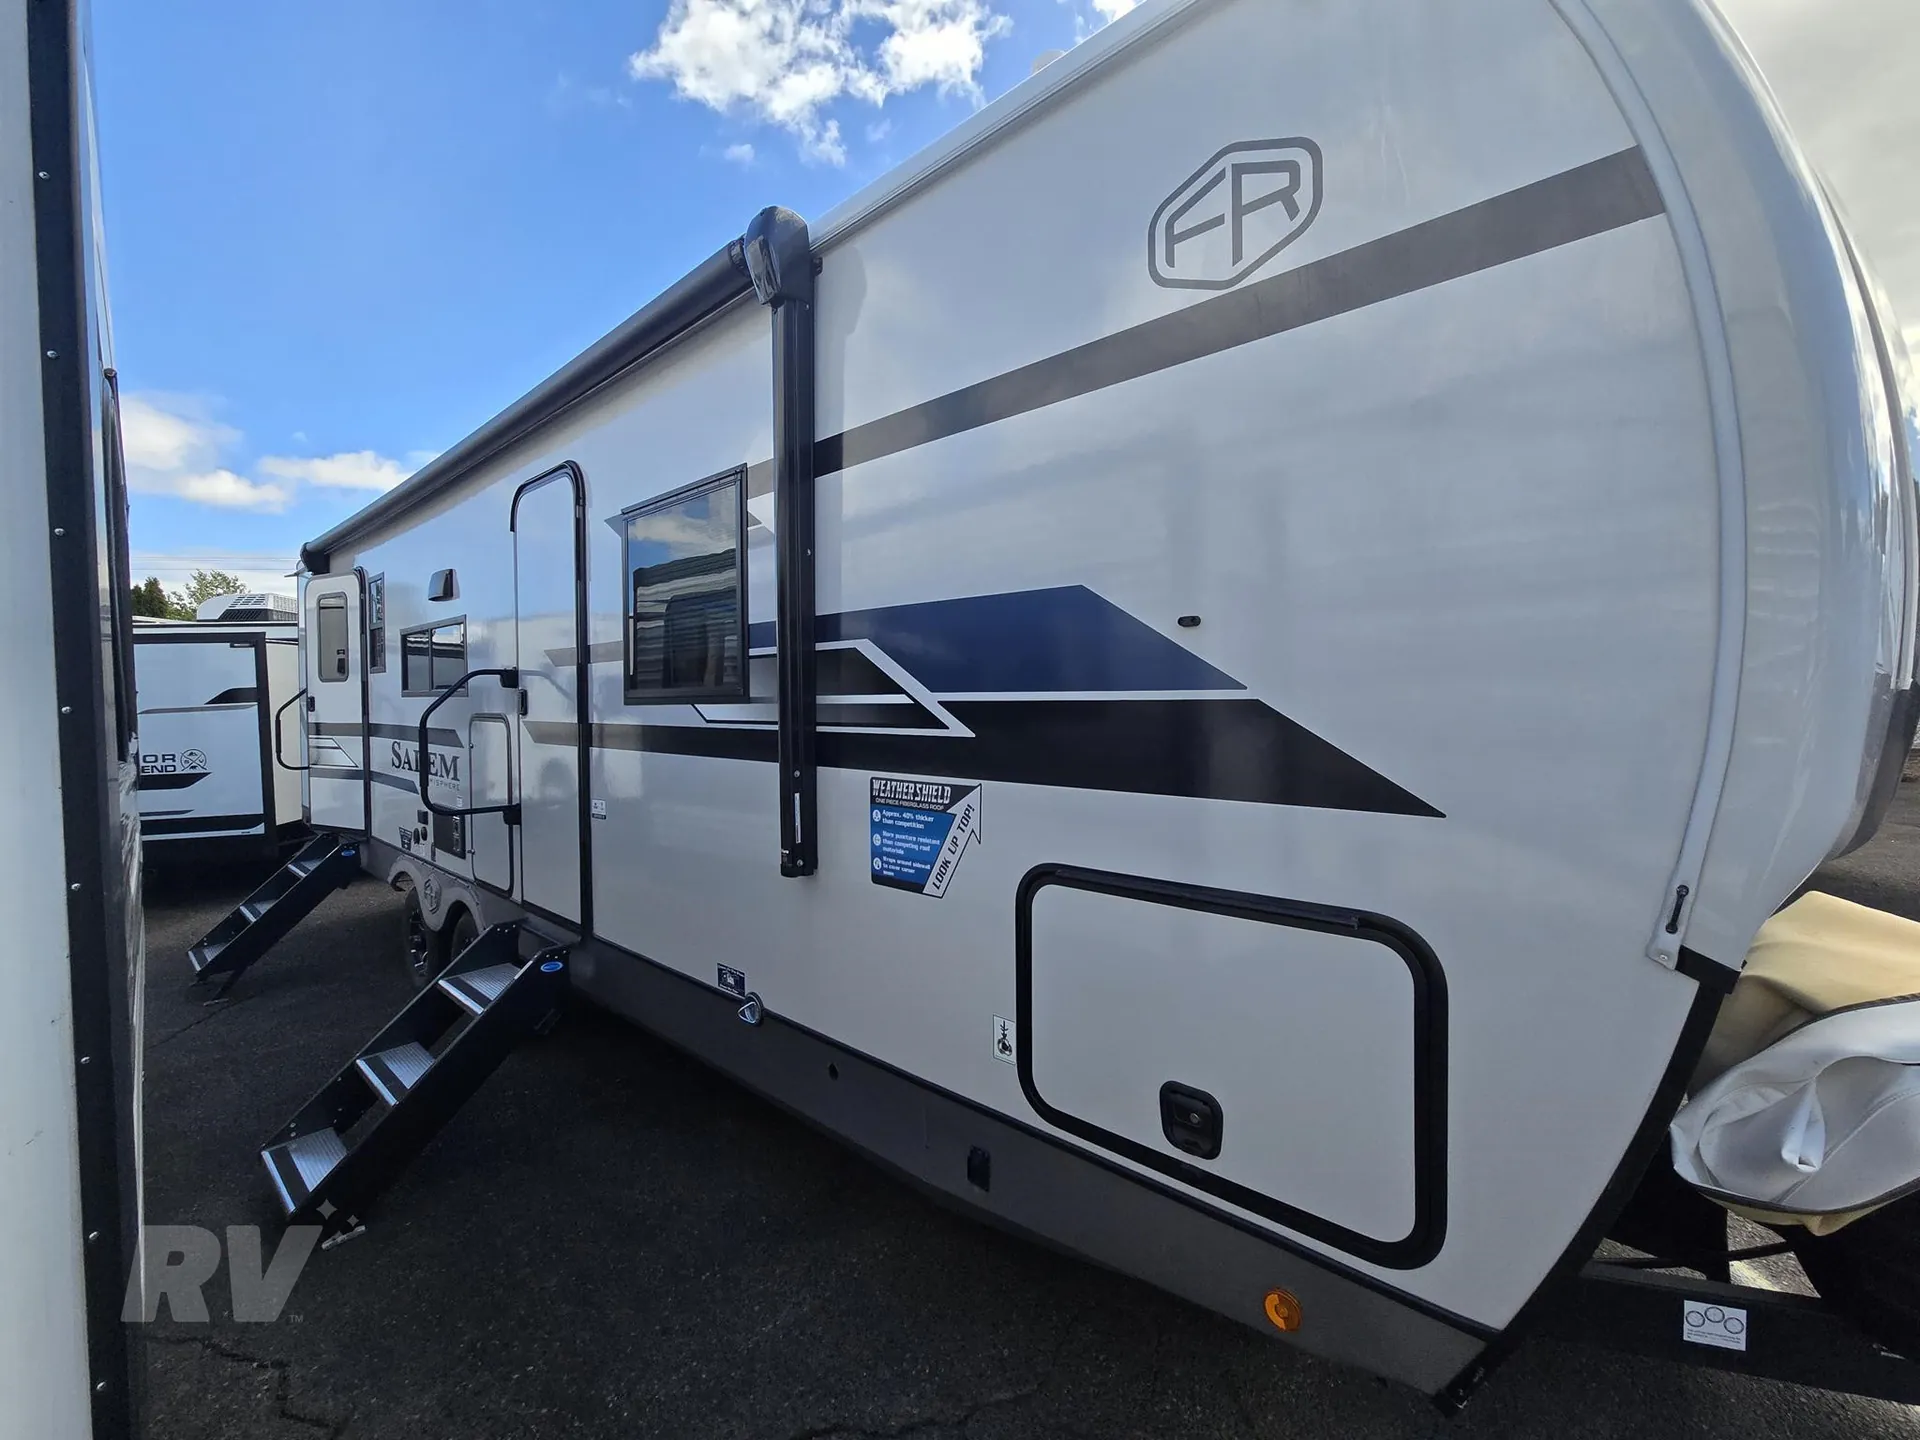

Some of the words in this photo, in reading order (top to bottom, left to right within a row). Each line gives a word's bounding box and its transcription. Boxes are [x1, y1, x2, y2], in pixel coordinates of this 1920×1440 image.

[872, 779, 952, 804] WEATHERSHIELD
[886, 798, 899, 806] PIECE
[930, 803, 945, 811] ROOF
[932, 857, 952, 890] LOOK
[947, 835, 960, 856] UP
[956, 803, 976, 834] TOP!
